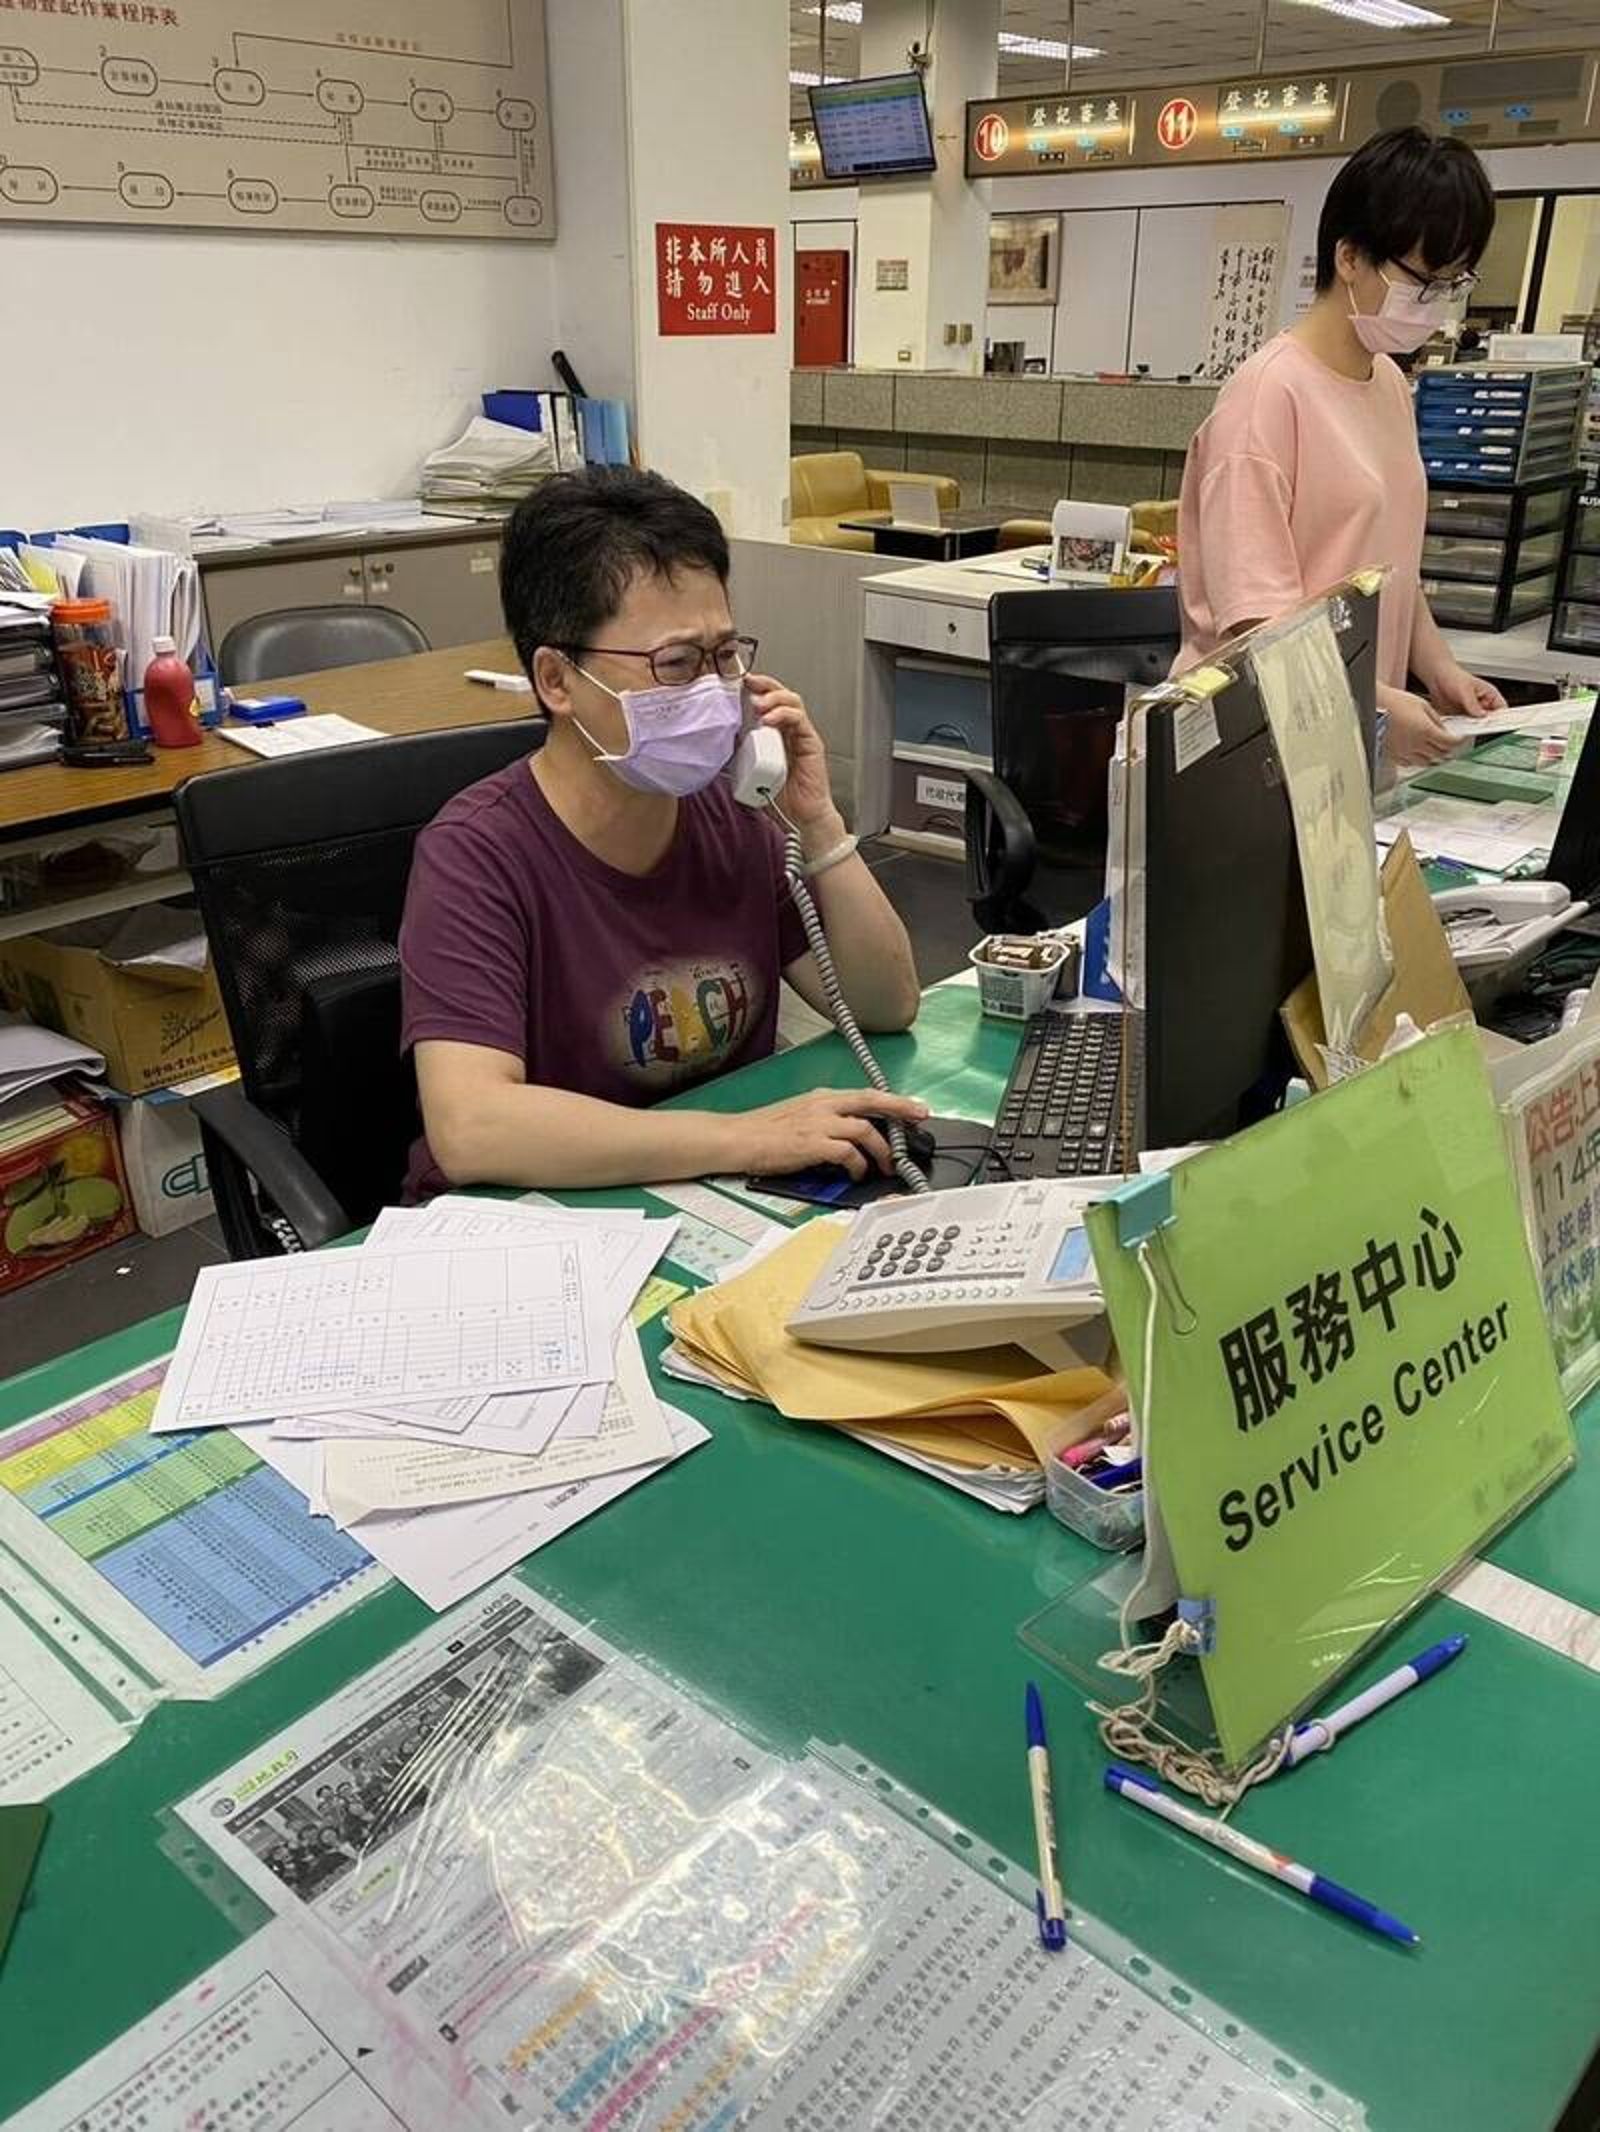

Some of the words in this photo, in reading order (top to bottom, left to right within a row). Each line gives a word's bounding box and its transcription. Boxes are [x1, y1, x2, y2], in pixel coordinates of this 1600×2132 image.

[1032, 99, 1121, 128] 登記審查
[1222, 81, 1329, 113] 登記審查
[979, 120, 1003, 154] 10
[1163, 104, 1189, 143] 11
[665, 234, 768, 270] 非本所人員
[665, 267, 771, 298] 請勿進入
[687, 301, 718, 320] Staff
[721, 302, 750, 325] Only
[1523, 1056, 1600, 1164] 公告上
[1219, 1206, 1463, 1432] 服務中心
[1218, 1403, 1385, 1552] Service
[1393, 1301, 1510, 1417] Center
